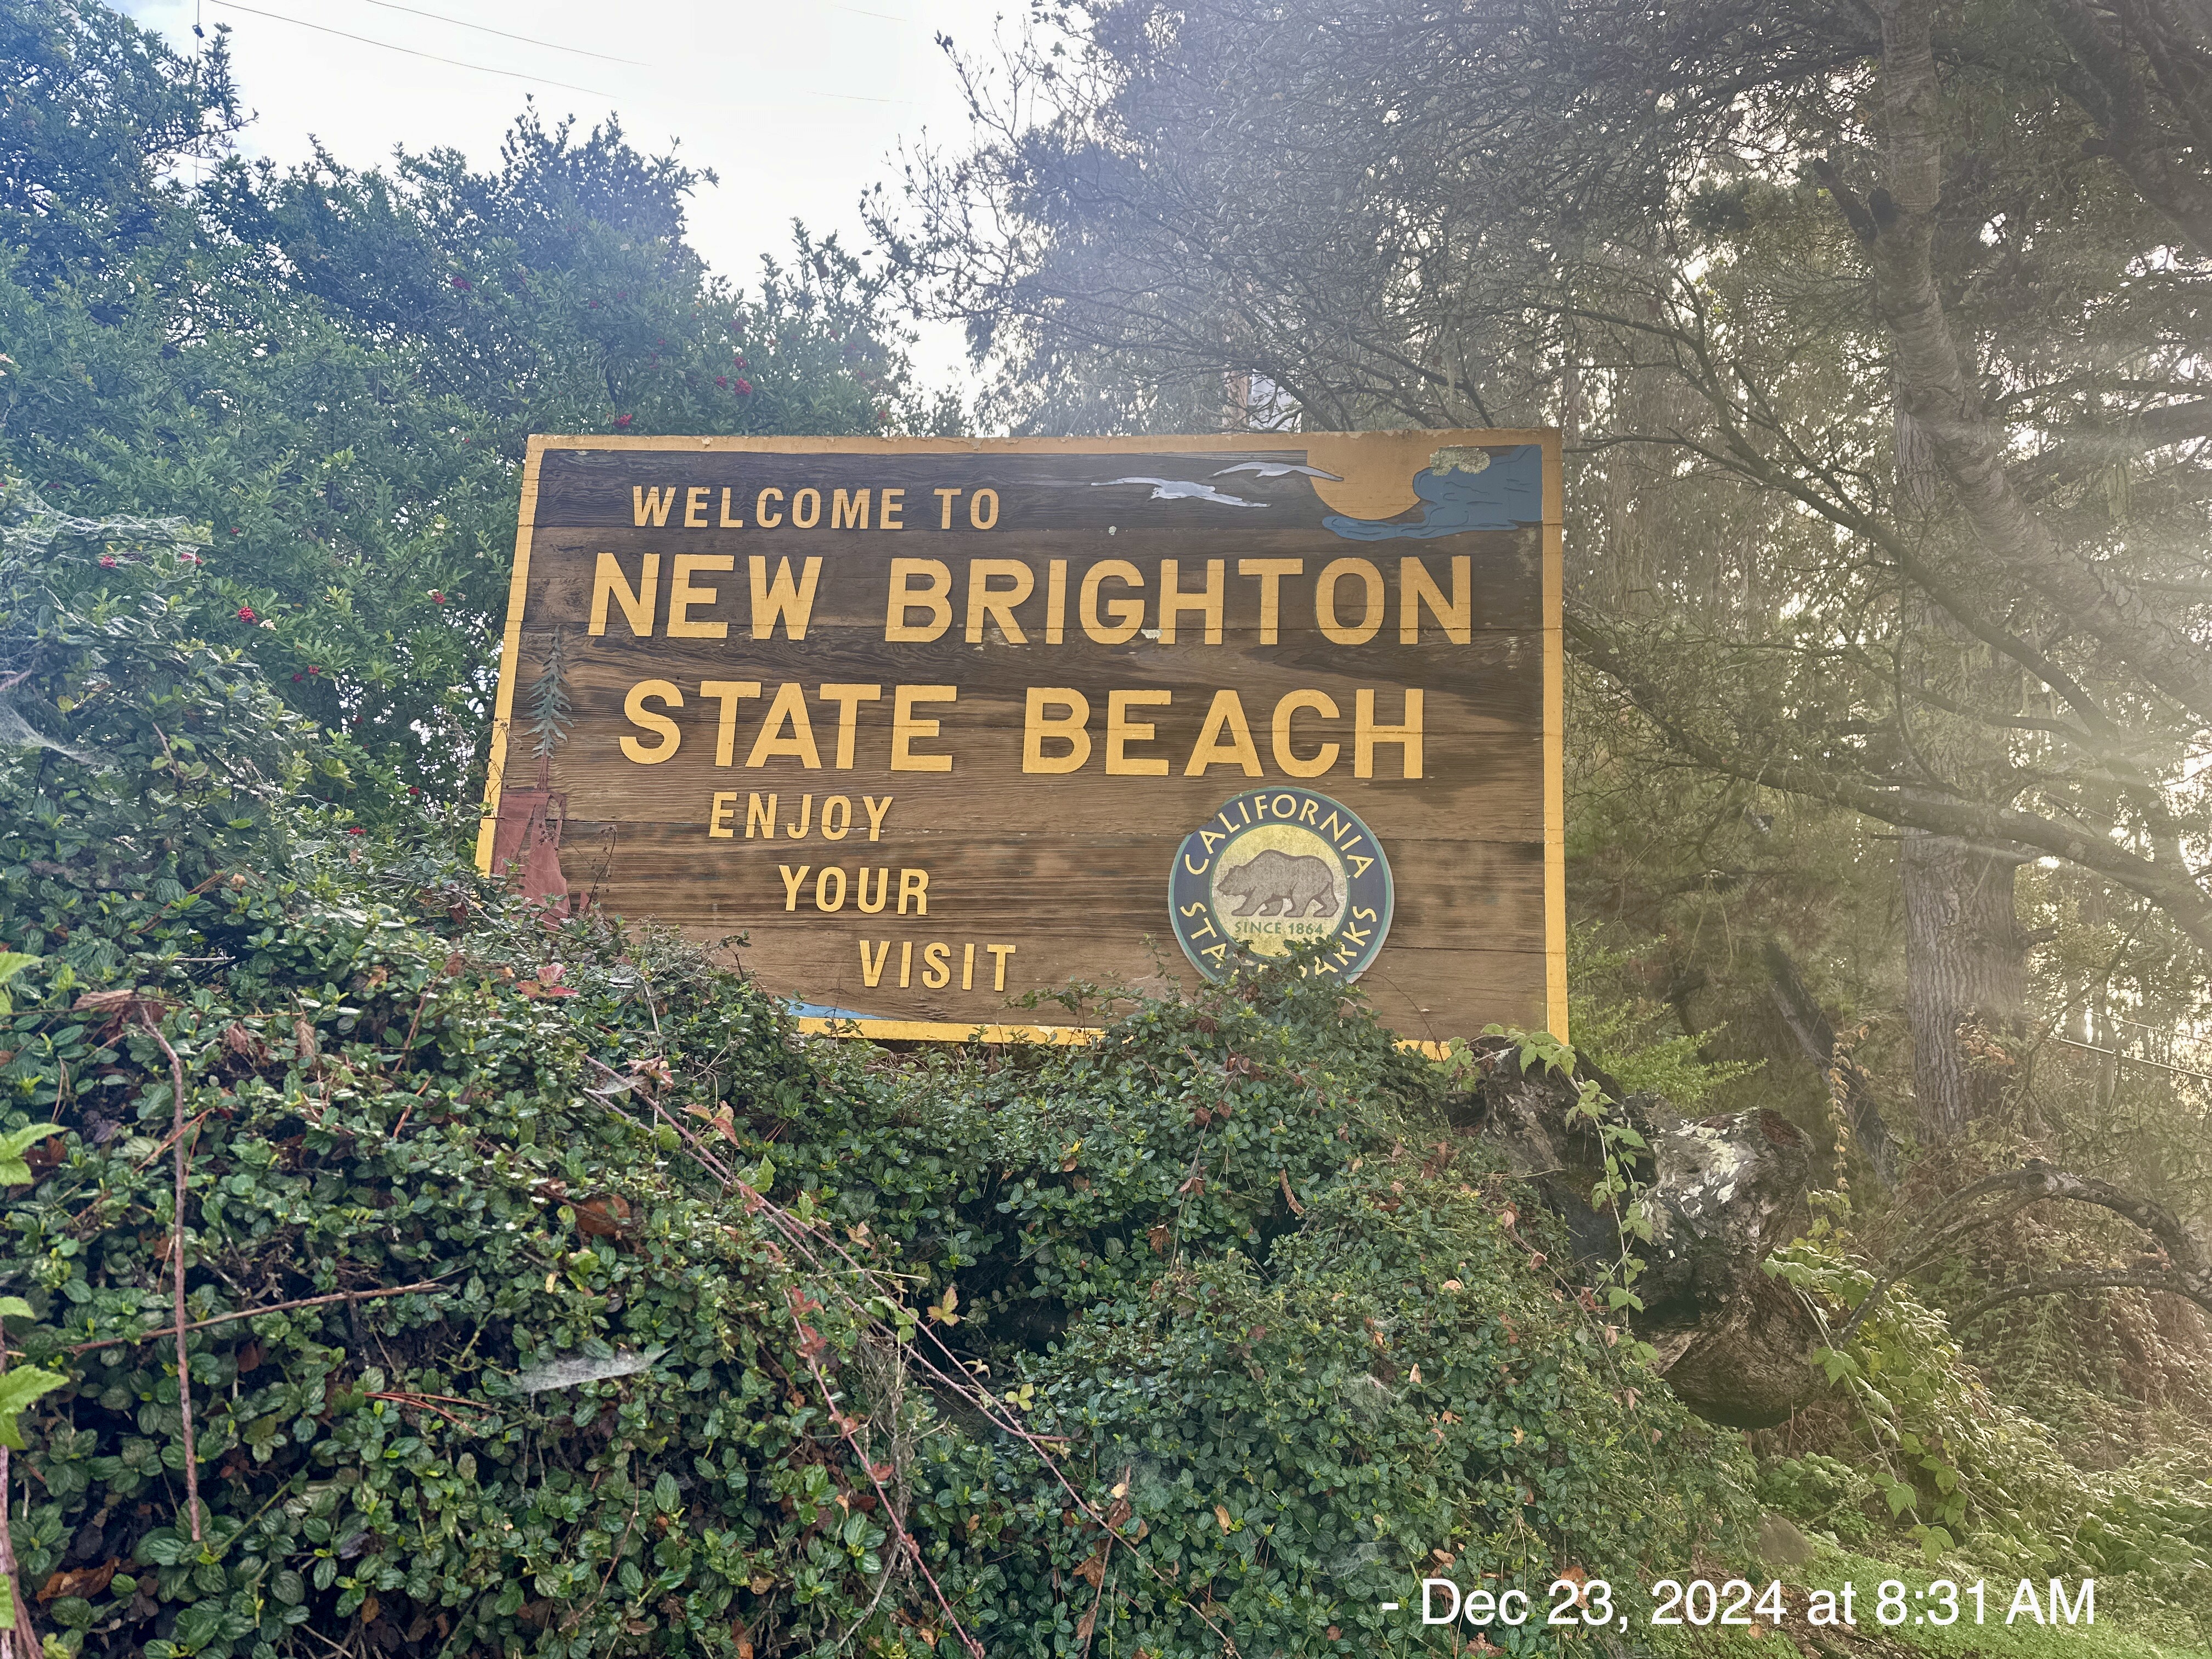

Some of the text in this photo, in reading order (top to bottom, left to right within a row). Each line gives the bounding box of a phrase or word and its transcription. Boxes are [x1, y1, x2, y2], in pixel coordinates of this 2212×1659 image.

[633, 486, 1000, 530] WELCOME TO
[588, 552, 1471, 645] NEW BRIGHTON
[619, 679, 1424, 779] STATE BEACH
[708, 792, 894, 842] ENJOY
[1185, 794, 1374, 879] CALIFORNIA
[778, 864, 930, 916] YOUR
[1180, 902, 1269, 980] STA
[1235, 921, 1324, 935] SINCE 1864
[859, 940, 1017, 992] VISIT
